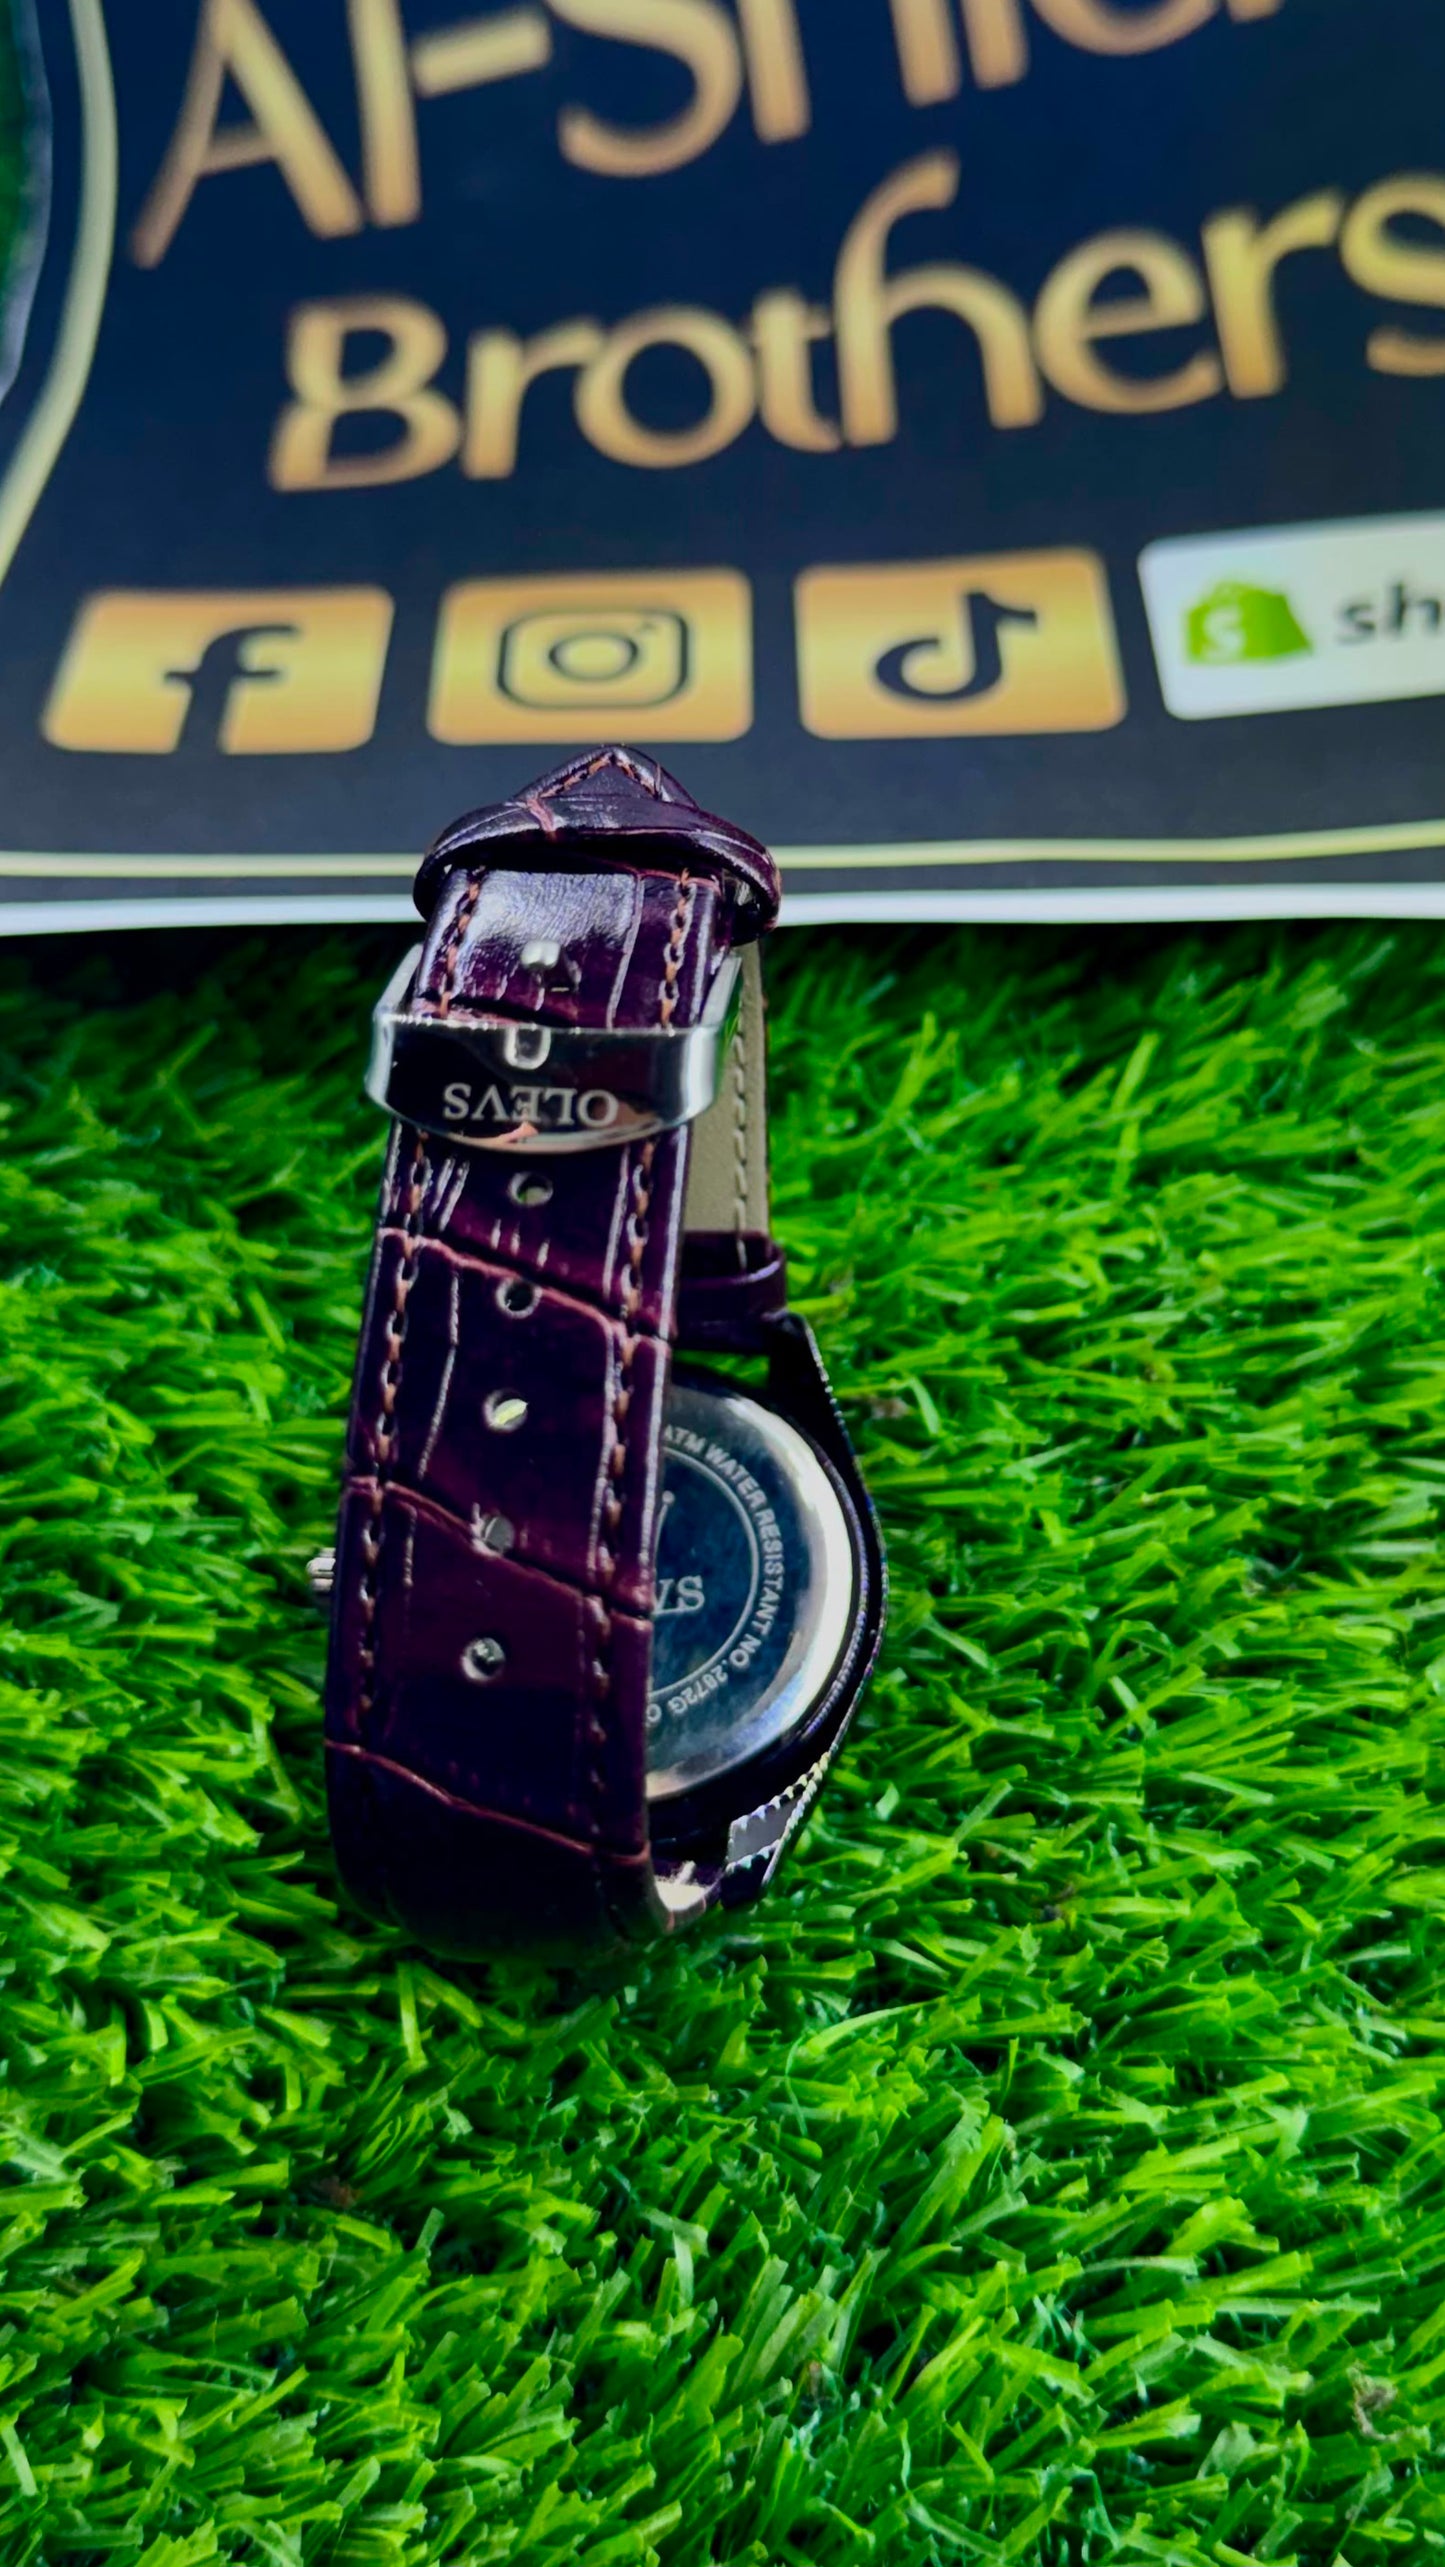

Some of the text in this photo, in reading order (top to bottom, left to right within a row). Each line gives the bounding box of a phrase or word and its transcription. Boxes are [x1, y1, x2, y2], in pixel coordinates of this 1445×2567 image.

[267, 146, 1445, 492] Brothers
[442, 1082, 621, 1129] OLEVS
[705, 1443, 768, 1510] WATER
[751, 1507, 784, 1636] RESISTANT
